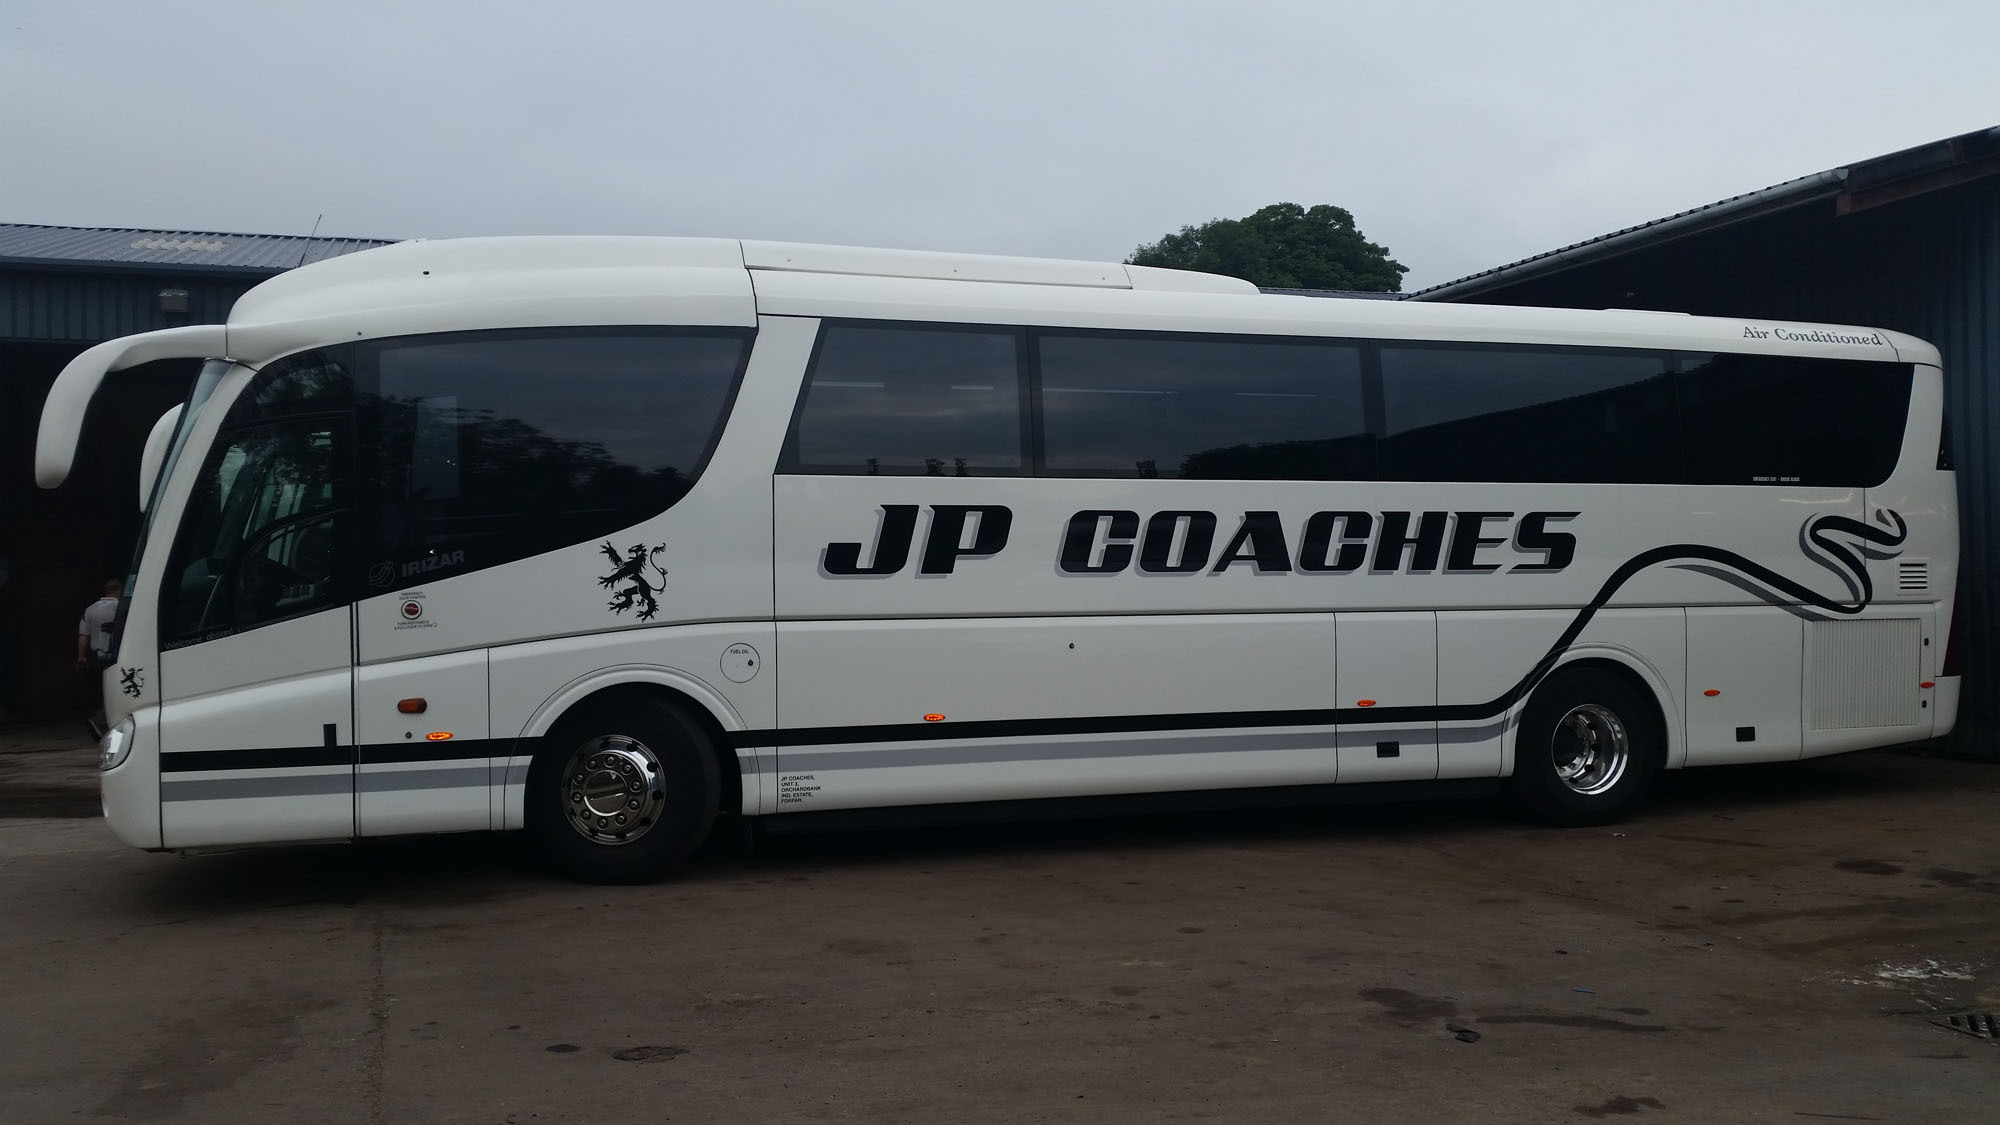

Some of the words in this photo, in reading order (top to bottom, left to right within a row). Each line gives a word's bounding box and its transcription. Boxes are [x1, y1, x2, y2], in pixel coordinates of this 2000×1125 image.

[1743, 325, 1769, 339] Air
[1774, 328, 1883, 346] Conditioned
[820, 504, 1013, 579] JP
[1055, 510, 1582, 576] COACHES
[401, 550, 465, 578] IRIZAR
[164, 637, 202, 650] Welcome
[206, 626, 234, 640] aboard
